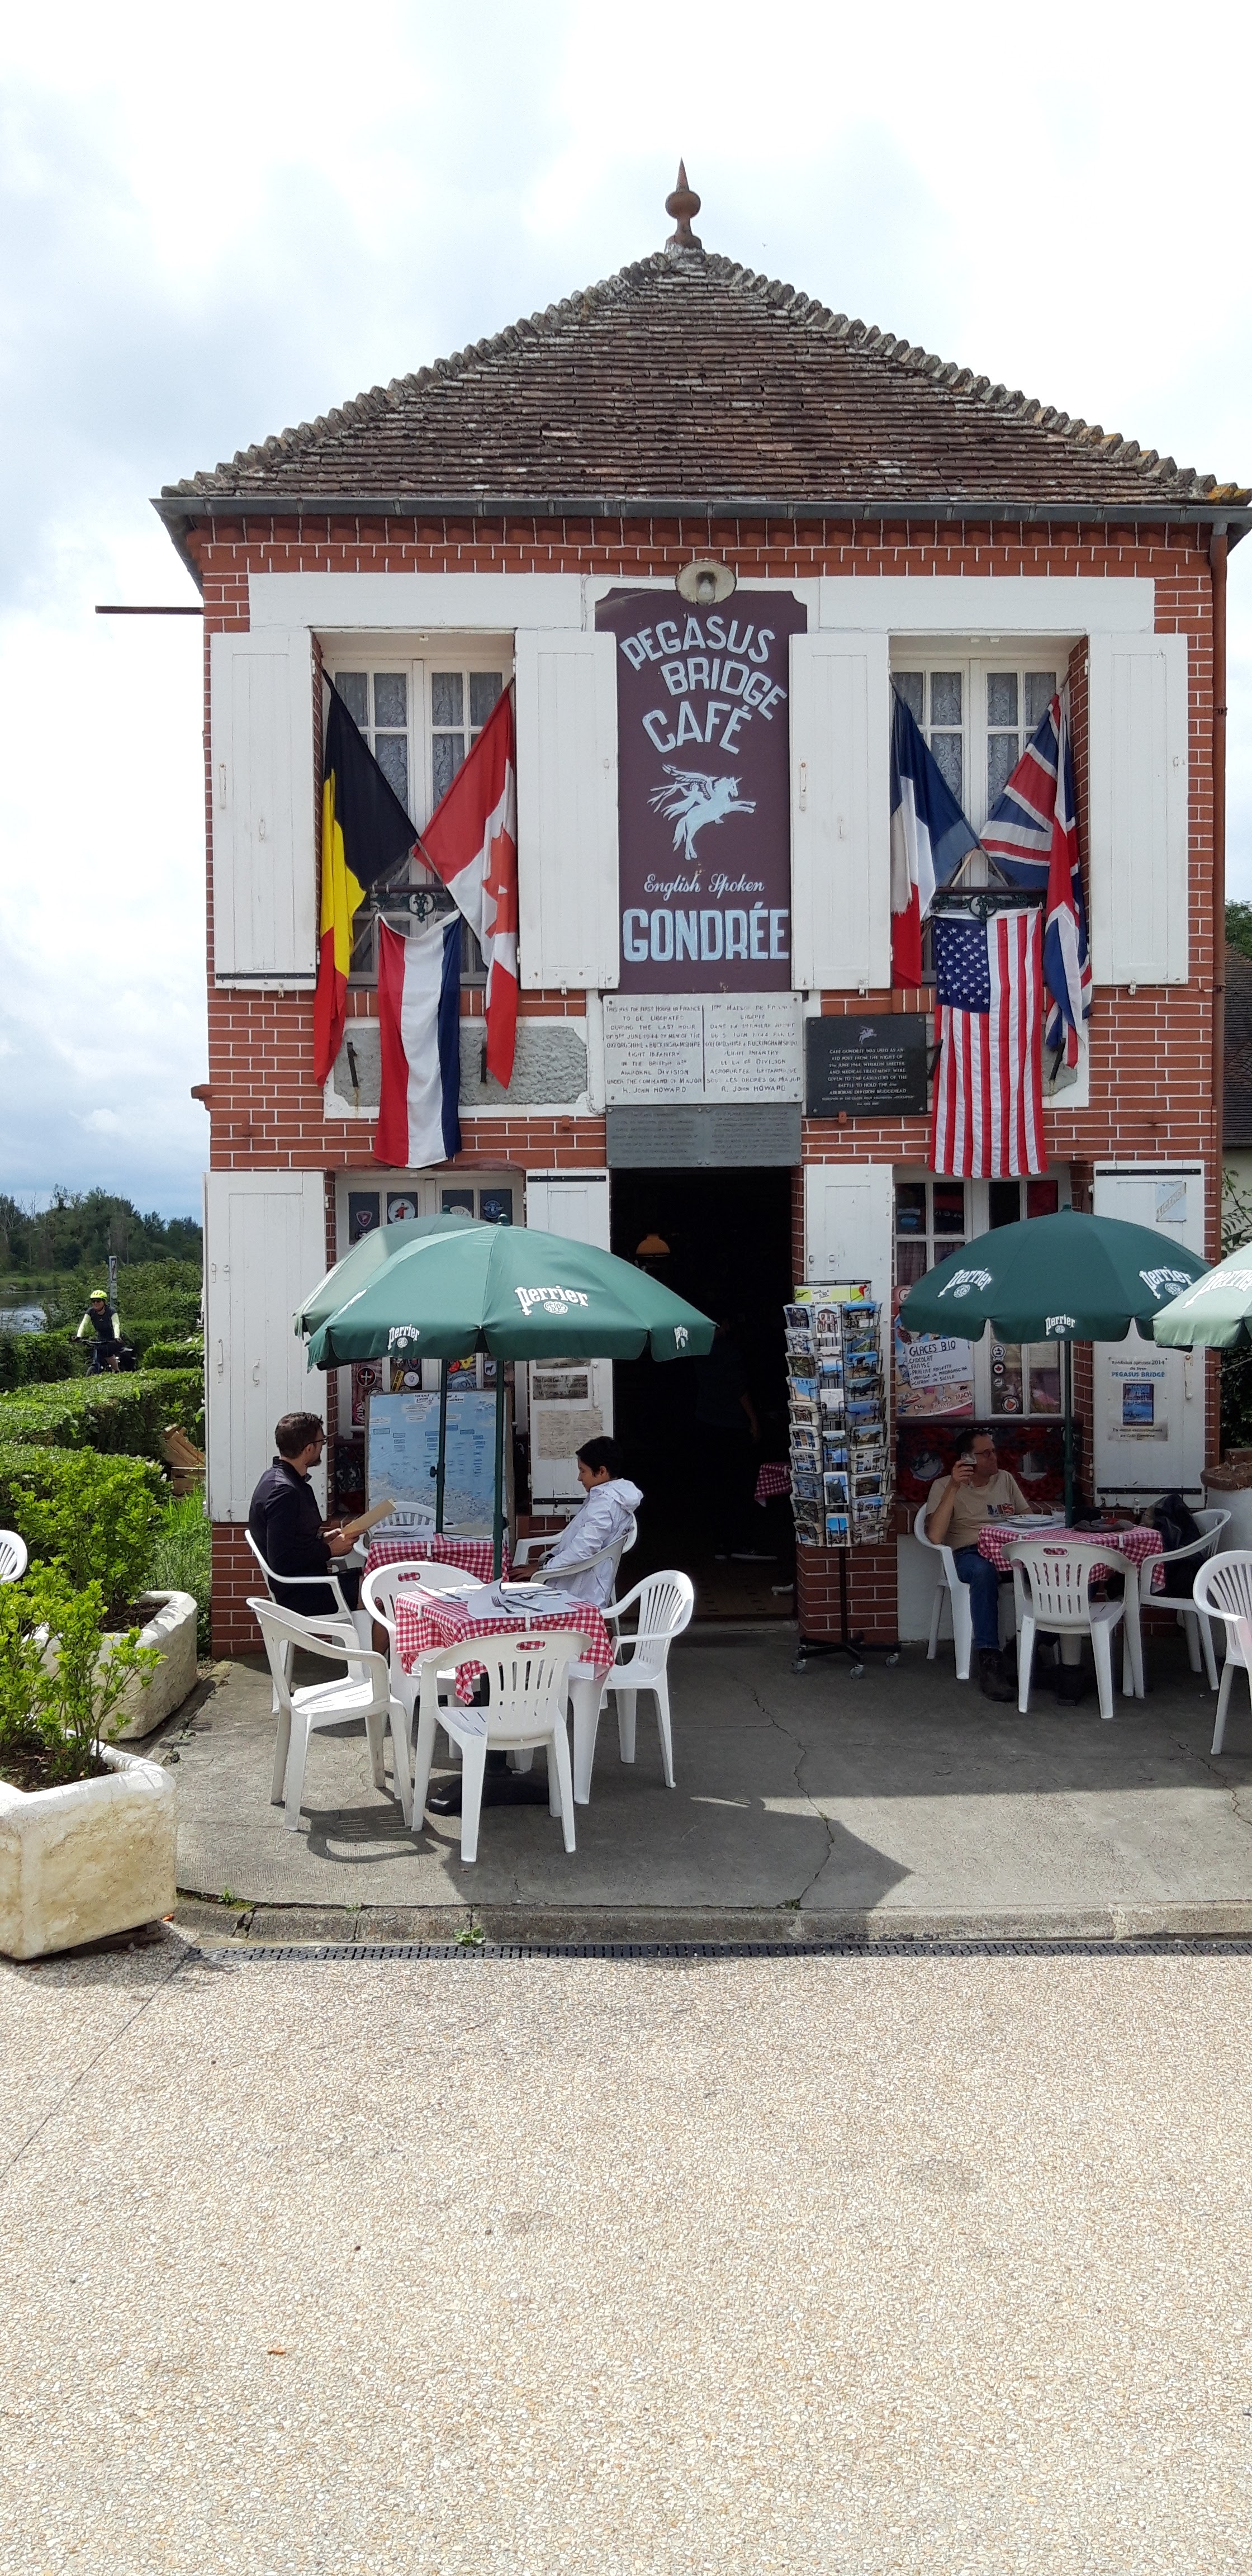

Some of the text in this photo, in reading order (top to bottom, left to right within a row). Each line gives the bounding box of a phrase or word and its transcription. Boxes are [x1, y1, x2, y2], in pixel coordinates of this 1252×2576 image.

[619, 615, 775, 671] PEGASUS
[660, 657, 787, 721] BRIDGE
[642, 701, 752, 755] CAFÉ
[644, 873, 765, 901] English Spoken
[622, 902, 789, 962] GONDRÉE
[909, 1341, 956, 1356] GLACES BIO
